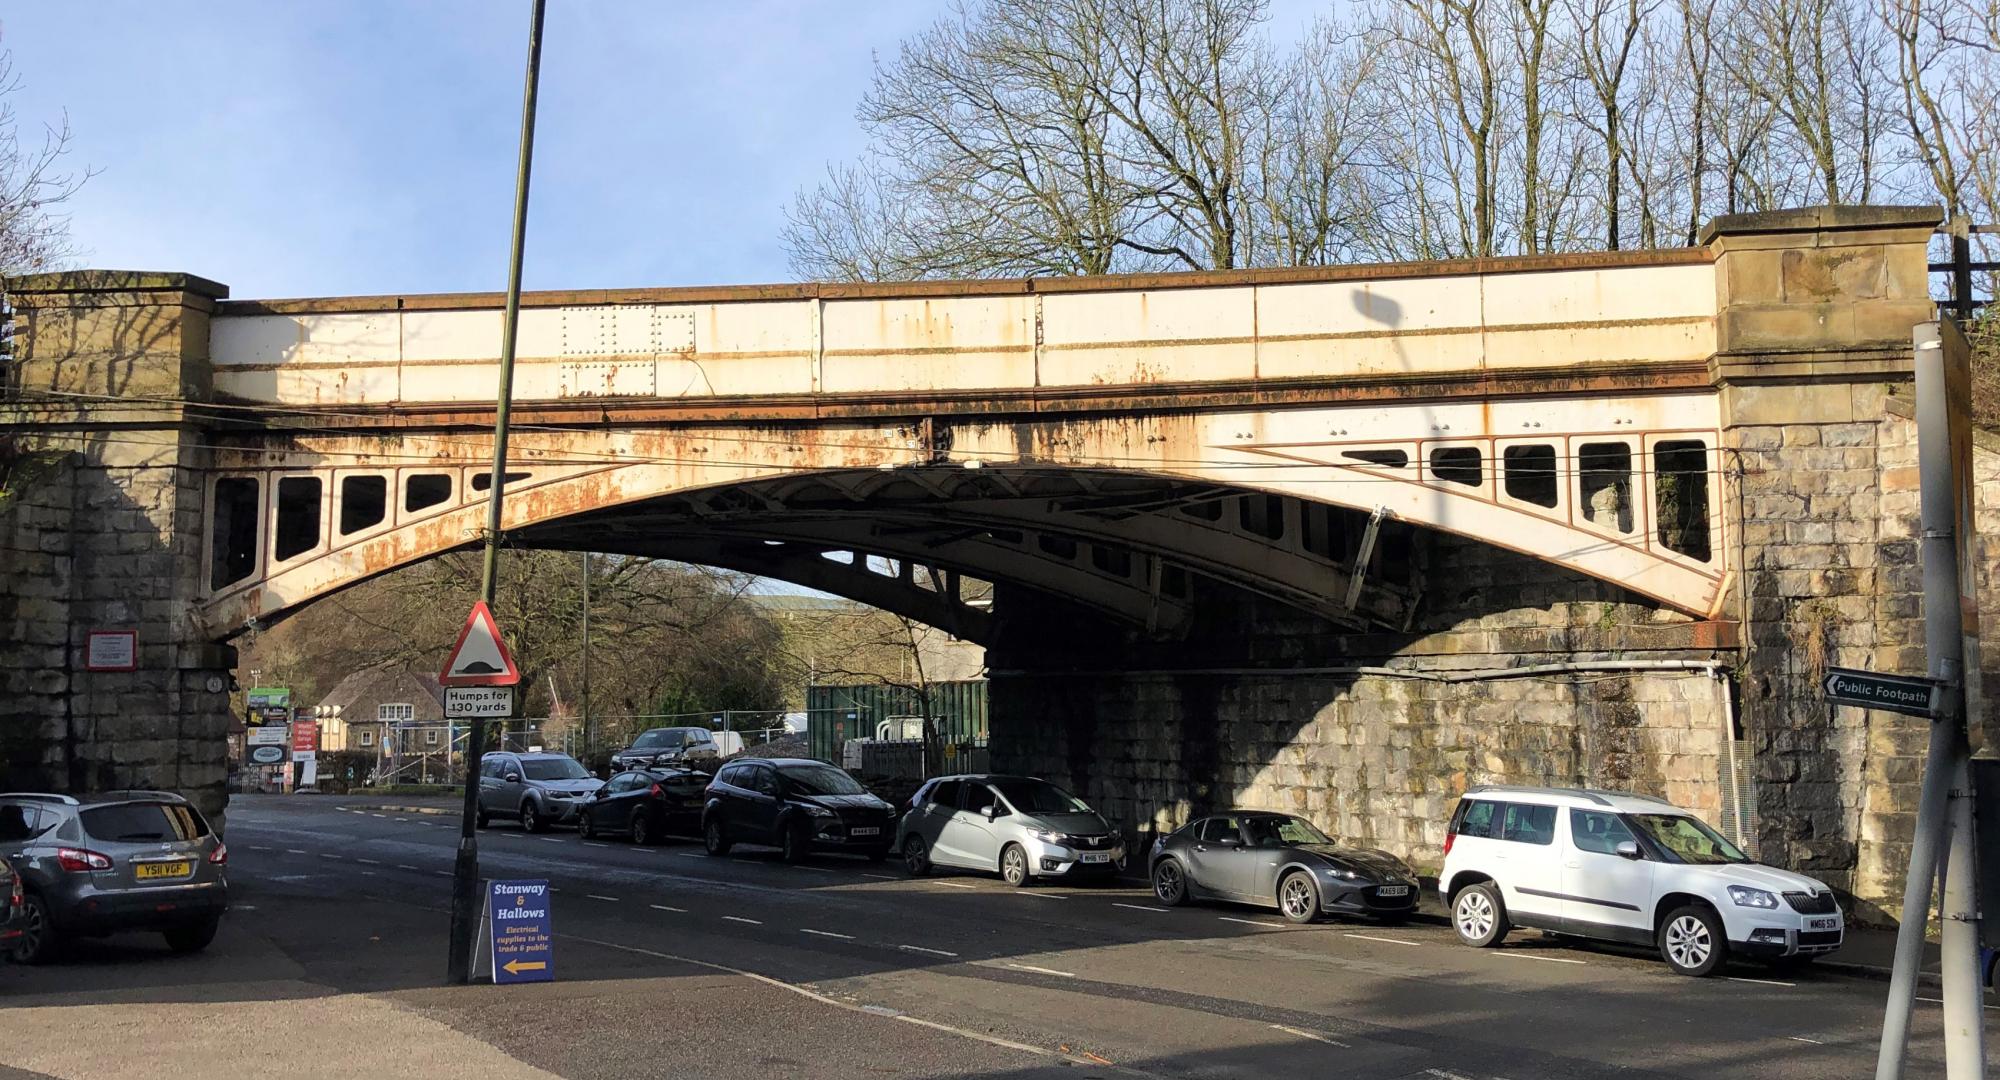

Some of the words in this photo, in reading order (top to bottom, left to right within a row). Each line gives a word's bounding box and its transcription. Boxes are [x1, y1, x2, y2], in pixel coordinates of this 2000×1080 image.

[450, 691, 489, 701] Humps
[491, 691, 508, 700] for
[1837, 680, 1872, 695] Public
[1875, 686, 1927, 702] Footpath
[451, 702, 473, 711] 130
[475, 702, 506, 712] yards
[145, 864, 162, 875] YS11
[165, 863, 183, 874] VGF
[494, 884, 546, 896] Stanway
[516, 895, 525, 905] &
[497, 908, 545, 919] Hallows
[506, 925, 539, 934] Electrical
[496, 935, 526, 945] supplies
[498, 944, 518, 952] trade
[526, 944, 549, 952] public
